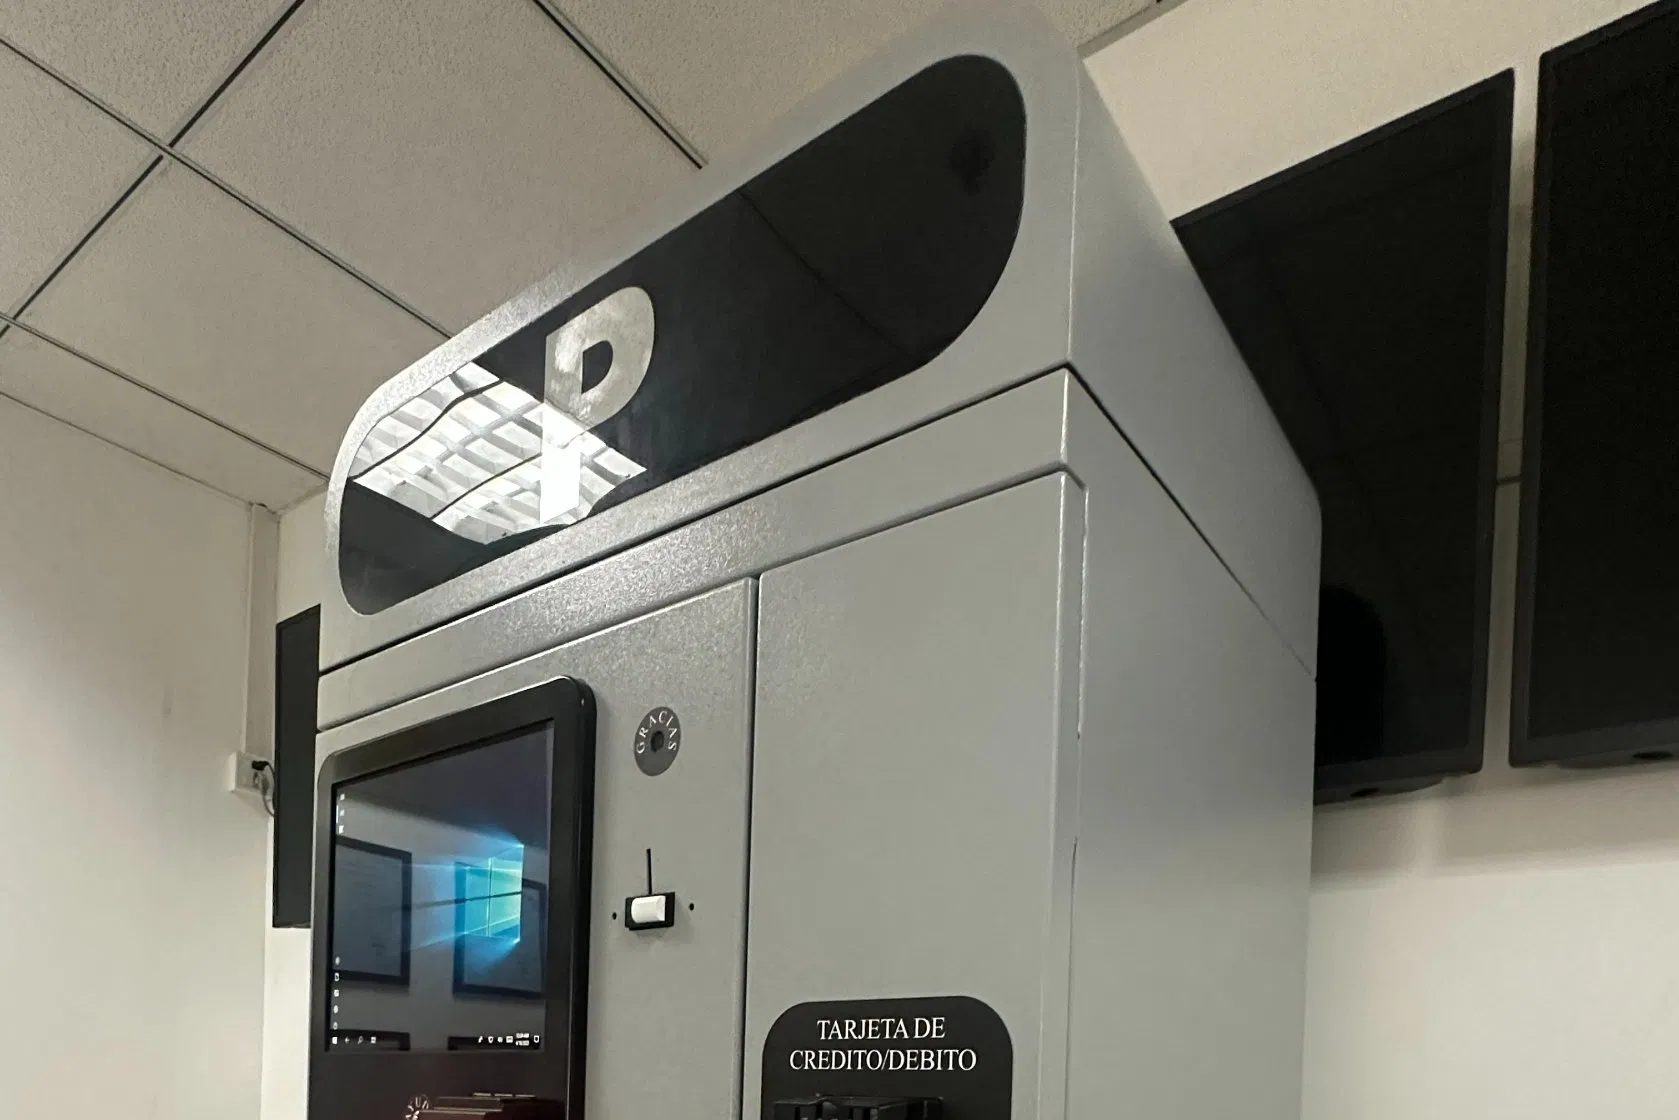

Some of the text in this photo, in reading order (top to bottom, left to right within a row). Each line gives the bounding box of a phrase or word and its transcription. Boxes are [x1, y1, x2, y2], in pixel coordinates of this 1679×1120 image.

[541, 286, 655, 525] P
[636, 710, 678, 755] GRACIAS
[817, 1016, 946, 1040] TARJETA DE
[788, 1048, 978, 1071] CREDITO/DEBITO
